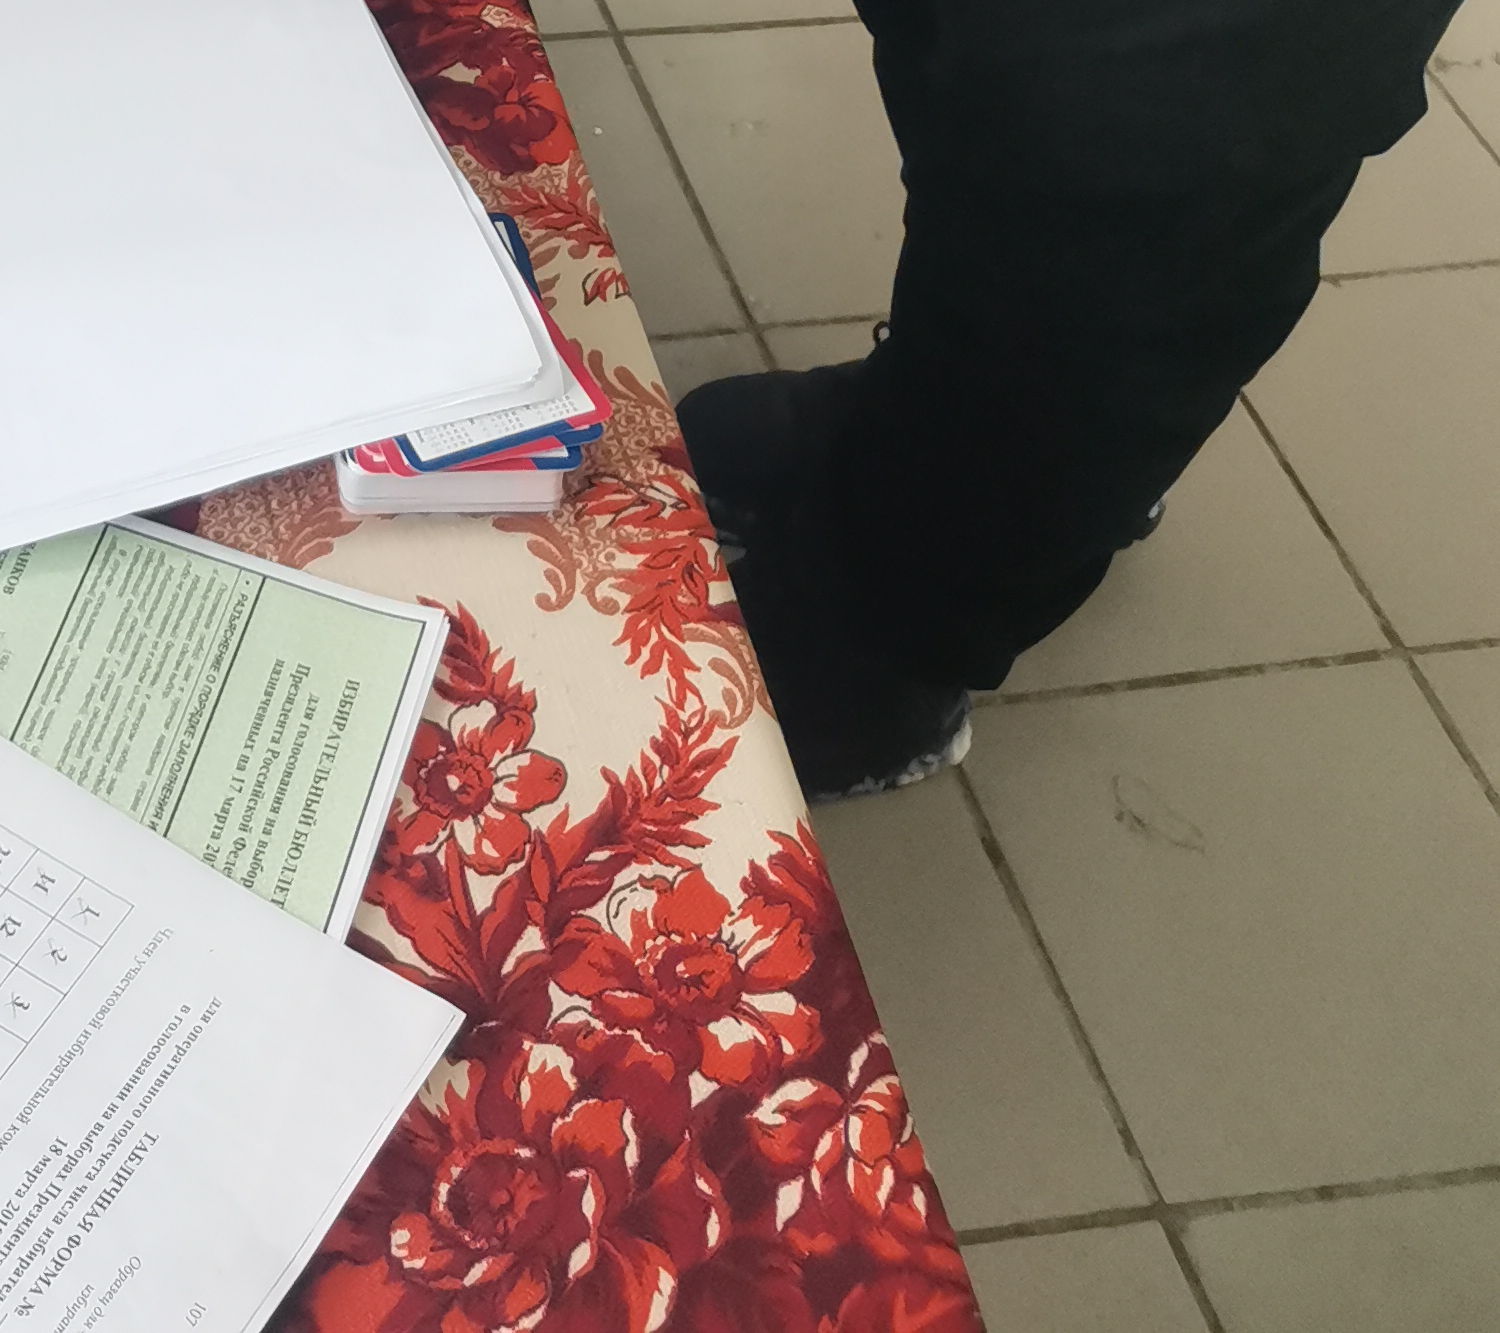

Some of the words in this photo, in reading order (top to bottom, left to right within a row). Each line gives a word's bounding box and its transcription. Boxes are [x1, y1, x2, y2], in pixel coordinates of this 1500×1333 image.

[206, 674, 216, 683] О
[184, 685, 212, 740] ПОРЯДКЕ
[243, 659, 285, 751] назначенных
[270, 663, 311, 744] Президента
[304, 693, 319, 720] для
[236, 754, 250, 771] на
[269, 723, 309, 814] голосования
[298, 679, 360, 827] ИЗБИРАТЕЛЬНЫЙ
[152, 739, 191, 820] ЗАПОЛНЕНИЯ
[230, 776, 245, 793] 17
[238, 748, 280, 834] Российской
[210, 797, 235, 840] марта
[262, 817, 276, 835] на
[33, 873, 55, 893] 11
[0, 916, 21, 937] 12
[142, 929, 173, 958] Член
[88, 956, 146, 1030] участковой
[181, 1005, 191, 1013] в
[200, 997, 221, 1024] для
[16, 1029, 92, 1125] избирательной
[116, 1015, 183, 1101] голосовании
[132, 1026, 202, 1118] оперативного
[102, 1103, 119, 1119] на
[50, 1138, 67, 1156] 18
[55, 1122, 105, 1181] выборах
[85, 1120, 135, 1181] подсчета
[15, 1155, 51, 1198] марта
[77, 1132, 159, 1233] ТАБЛИЧНАЯ
[52, 1185, 88, 1225] числа
[29, 1235, 81, 1294] ФОРМА
[98, 1257, 141, 1306] Образец
[14, 1297, 35, 1316] №
[84, 1307, 104, 1329] для
[186, 1302, 206, 1327] 107
